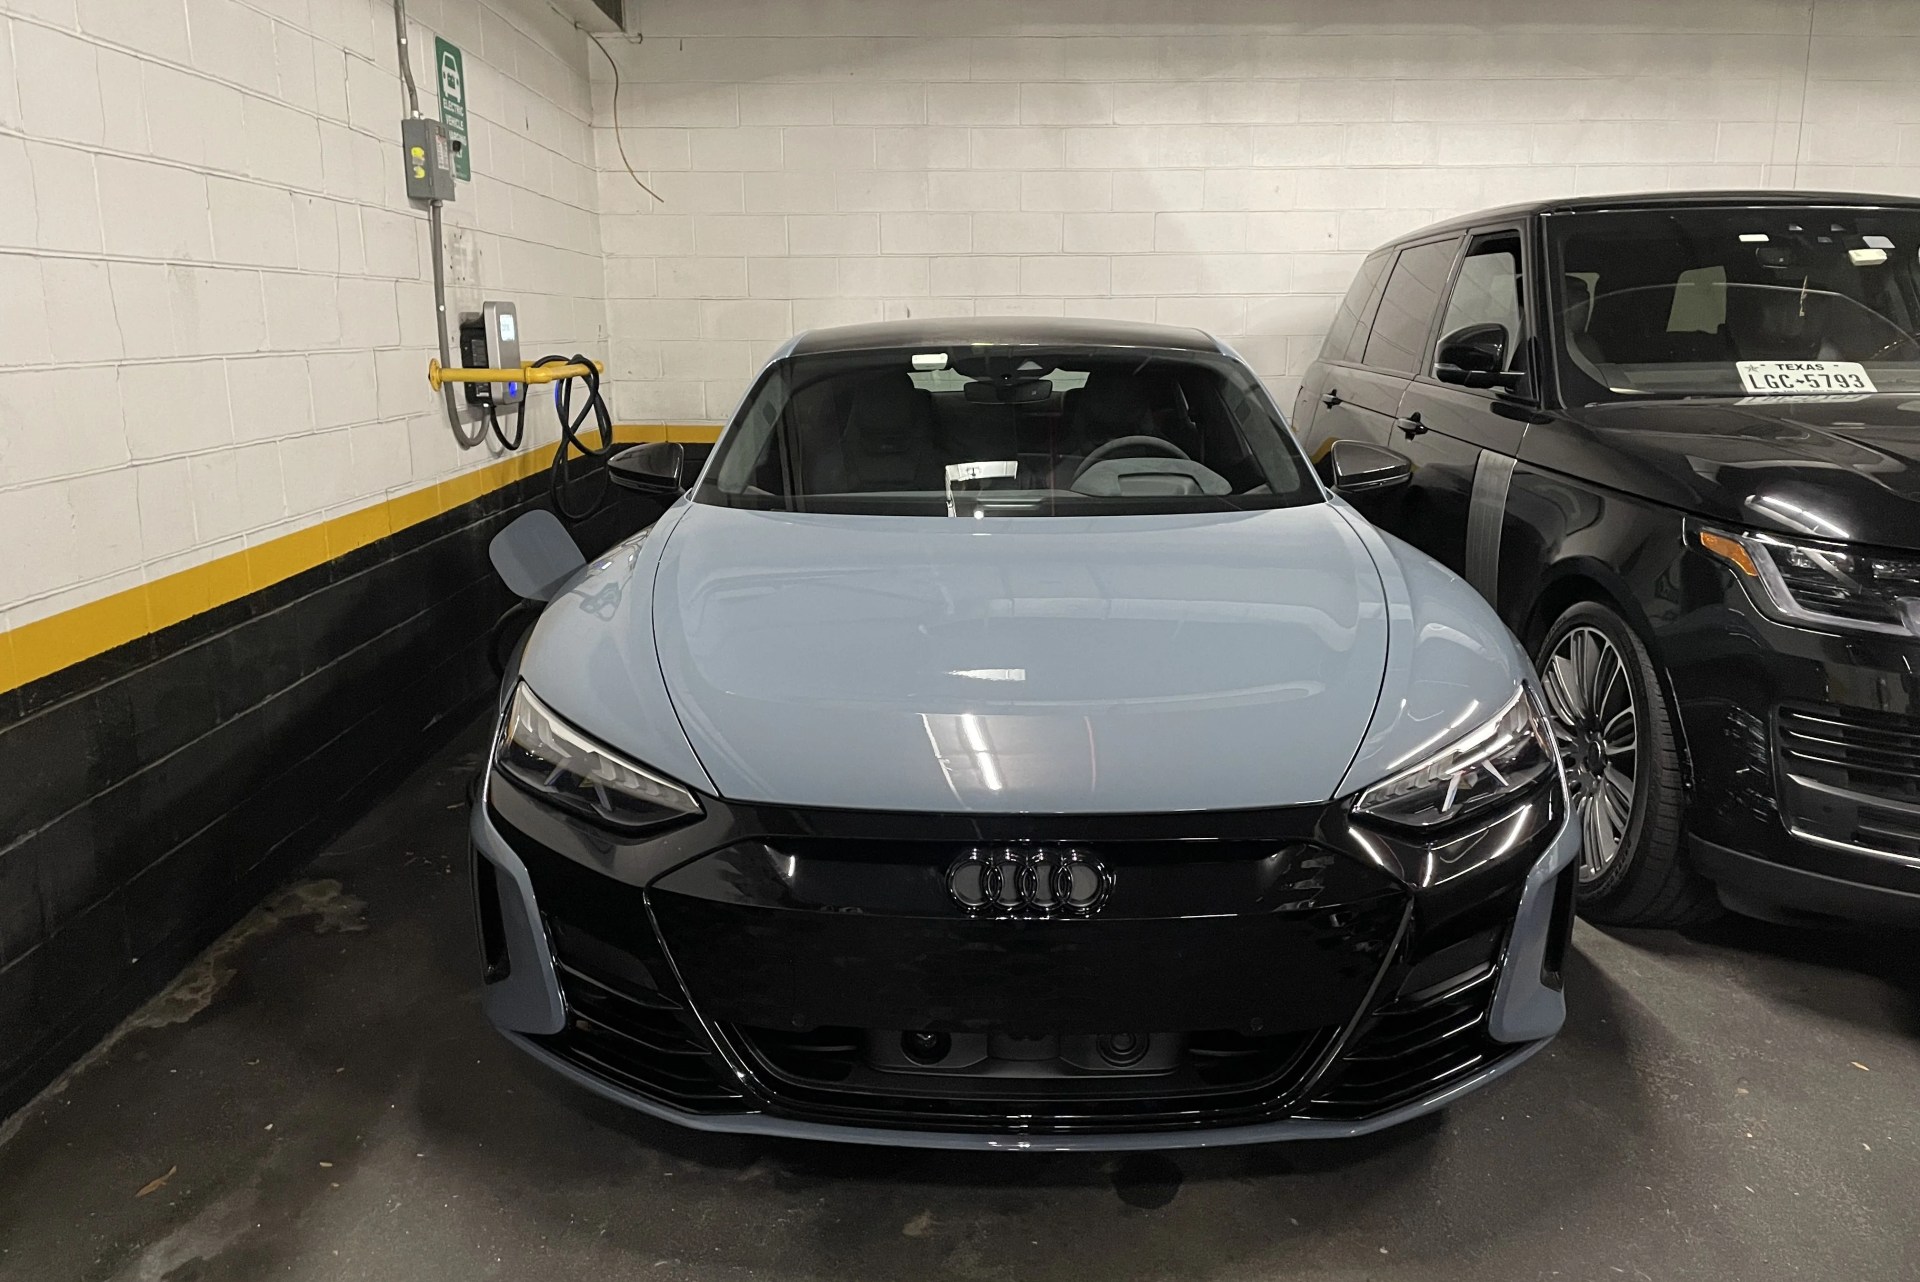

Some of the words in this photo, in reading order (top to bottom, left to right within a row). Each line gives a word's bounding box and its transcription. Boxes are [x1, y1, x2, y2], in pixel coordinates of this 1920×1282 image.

[443, 98, 464, 117] ELECTRIC
[445, 114, 464, 131] VEHICLE
[1775, 363, 1825, 371] TEXAS
